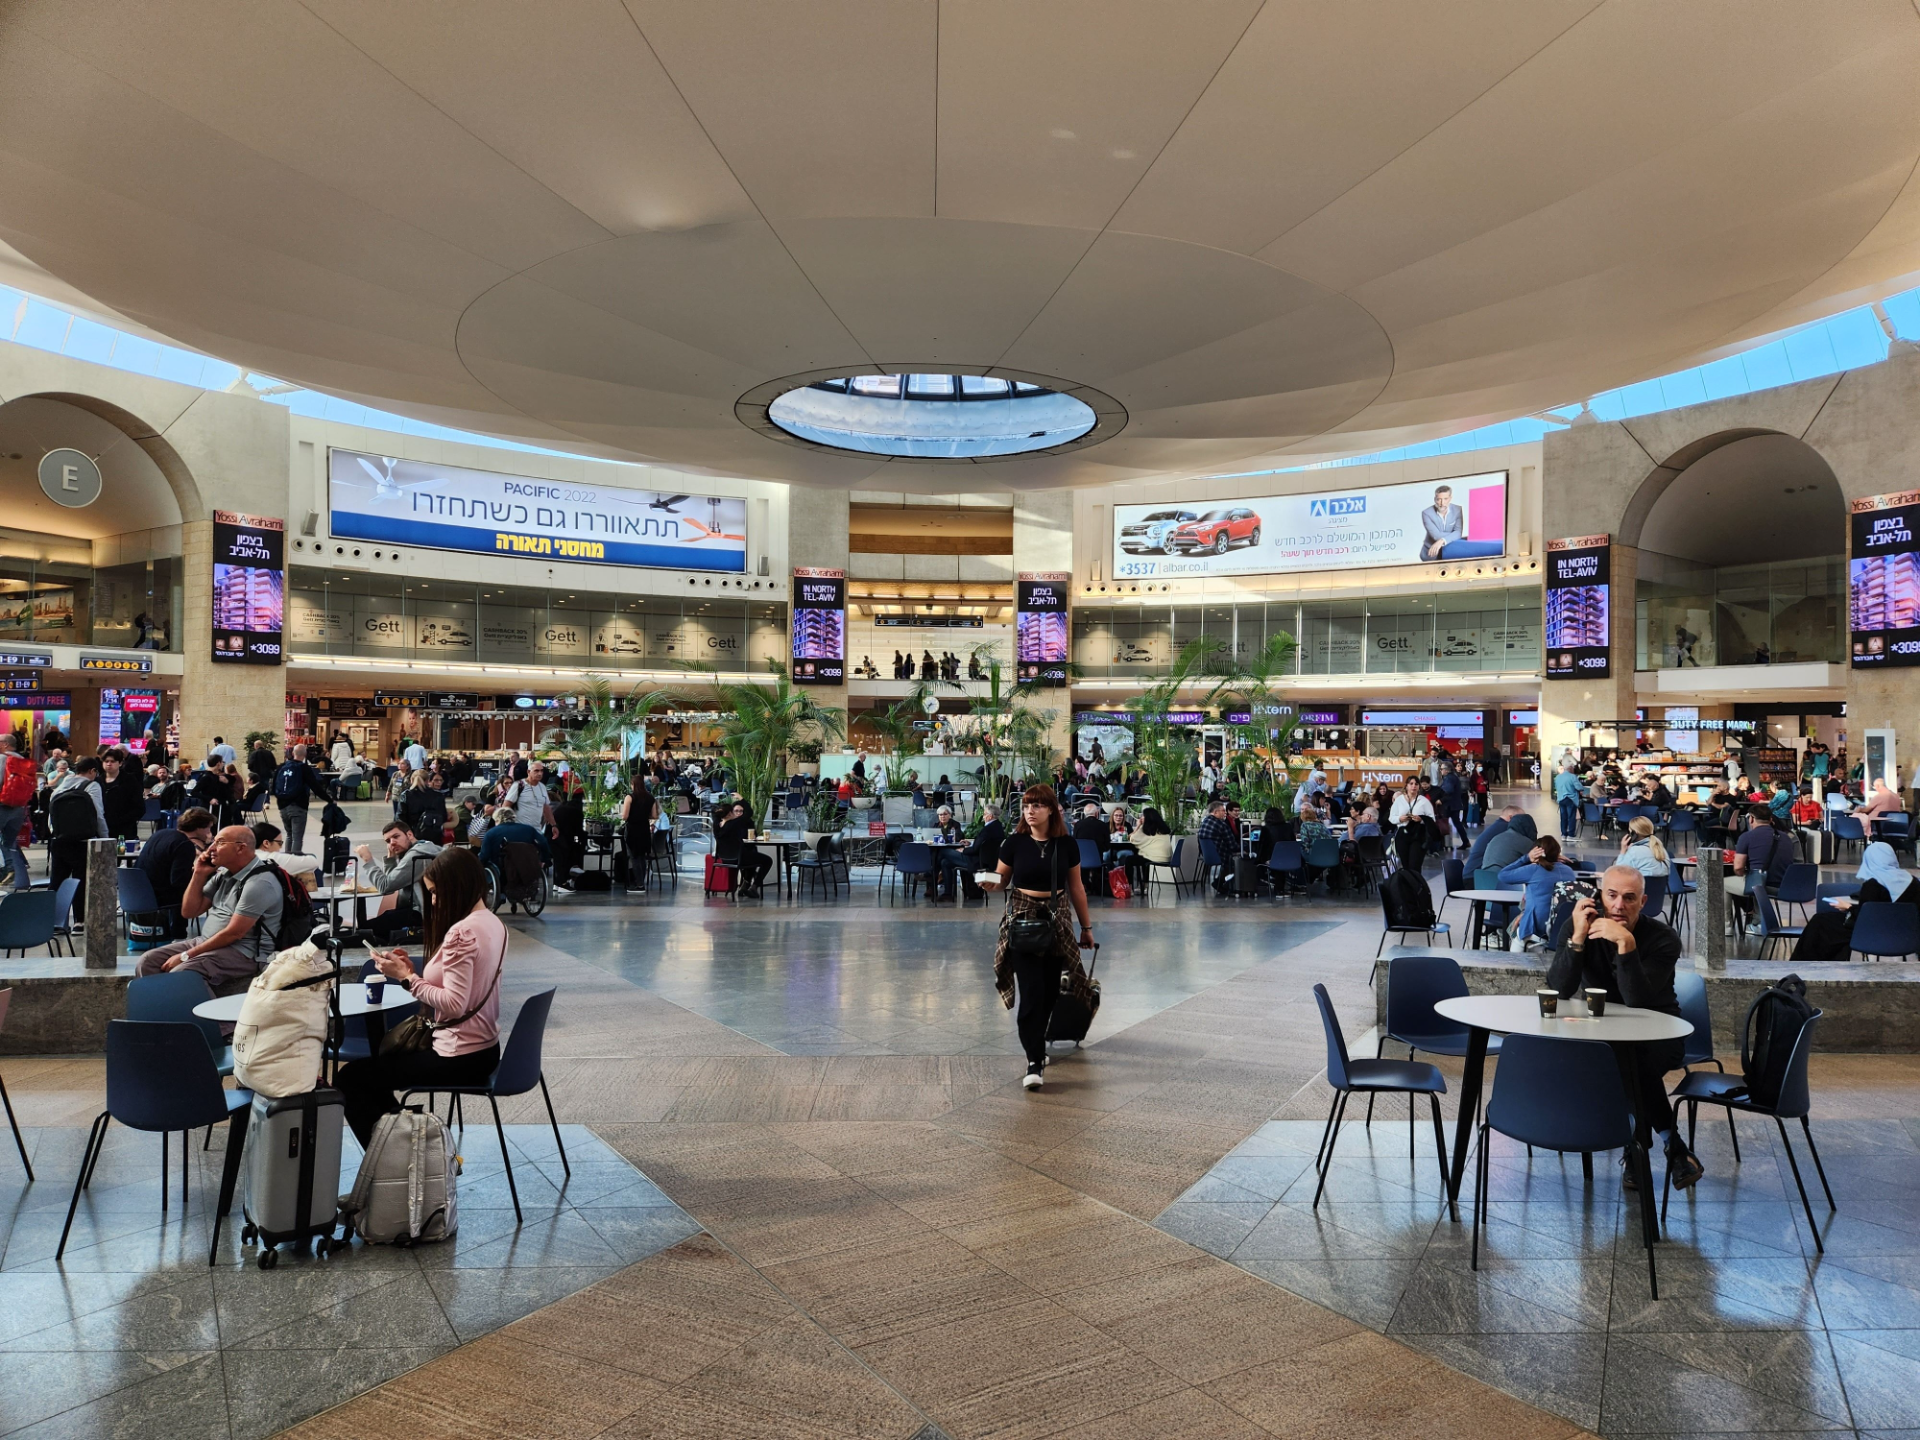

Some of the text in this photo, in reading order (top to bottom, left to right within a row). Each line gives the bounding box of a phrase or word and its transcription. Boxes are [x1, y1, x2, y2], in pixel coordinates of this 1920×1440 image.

[62, 464, 78, 492] E
[504, 482, 596, 504] PACIFIC 2022
[1331, 498, 1364, 514] אלבר
[1852, 500, 1874, 512] Yossi
[216, 512, 283, 529] Yossi Avrahami
[413, 492, 679, 538] תתאווררו גם כשתחזרו
[1874, 516, 1904, 533] בצפון
[237, 534, 263, 546] בצפון
[1275, 528, 1403, 546] המתכון המושלם לרכב חדש
[1548, 535, 1608, 550] Yossi Avrahami
[1866, 529, 1912, 546] תל-אביב
[496, 533, 604, 558] מחסני תאורה
[1335, 546, 1349, 554] רכב
[229, 546, 270, 559] תל-אביב
[1281, 550, 1300, 558] שעה!
[1163, 561, 1208, 572] albar.co.il
[1558, 556, 1598, 568] IN NORTH
[811, 569, 844, 578] Avrahami
[1558, 566, 1597, 578] TEL-AVIV
[803, 593, 835, 601] TEL-AVIV
[1033, 588, 1052, 596] בצפון
[1028, 596, 1057, 605] תל-אביב
[27, 696, 65, 705] DUTY FREE
[1671, 721, 1698, 729] DUTY
[1700, 721, 1724, 729] FREE
